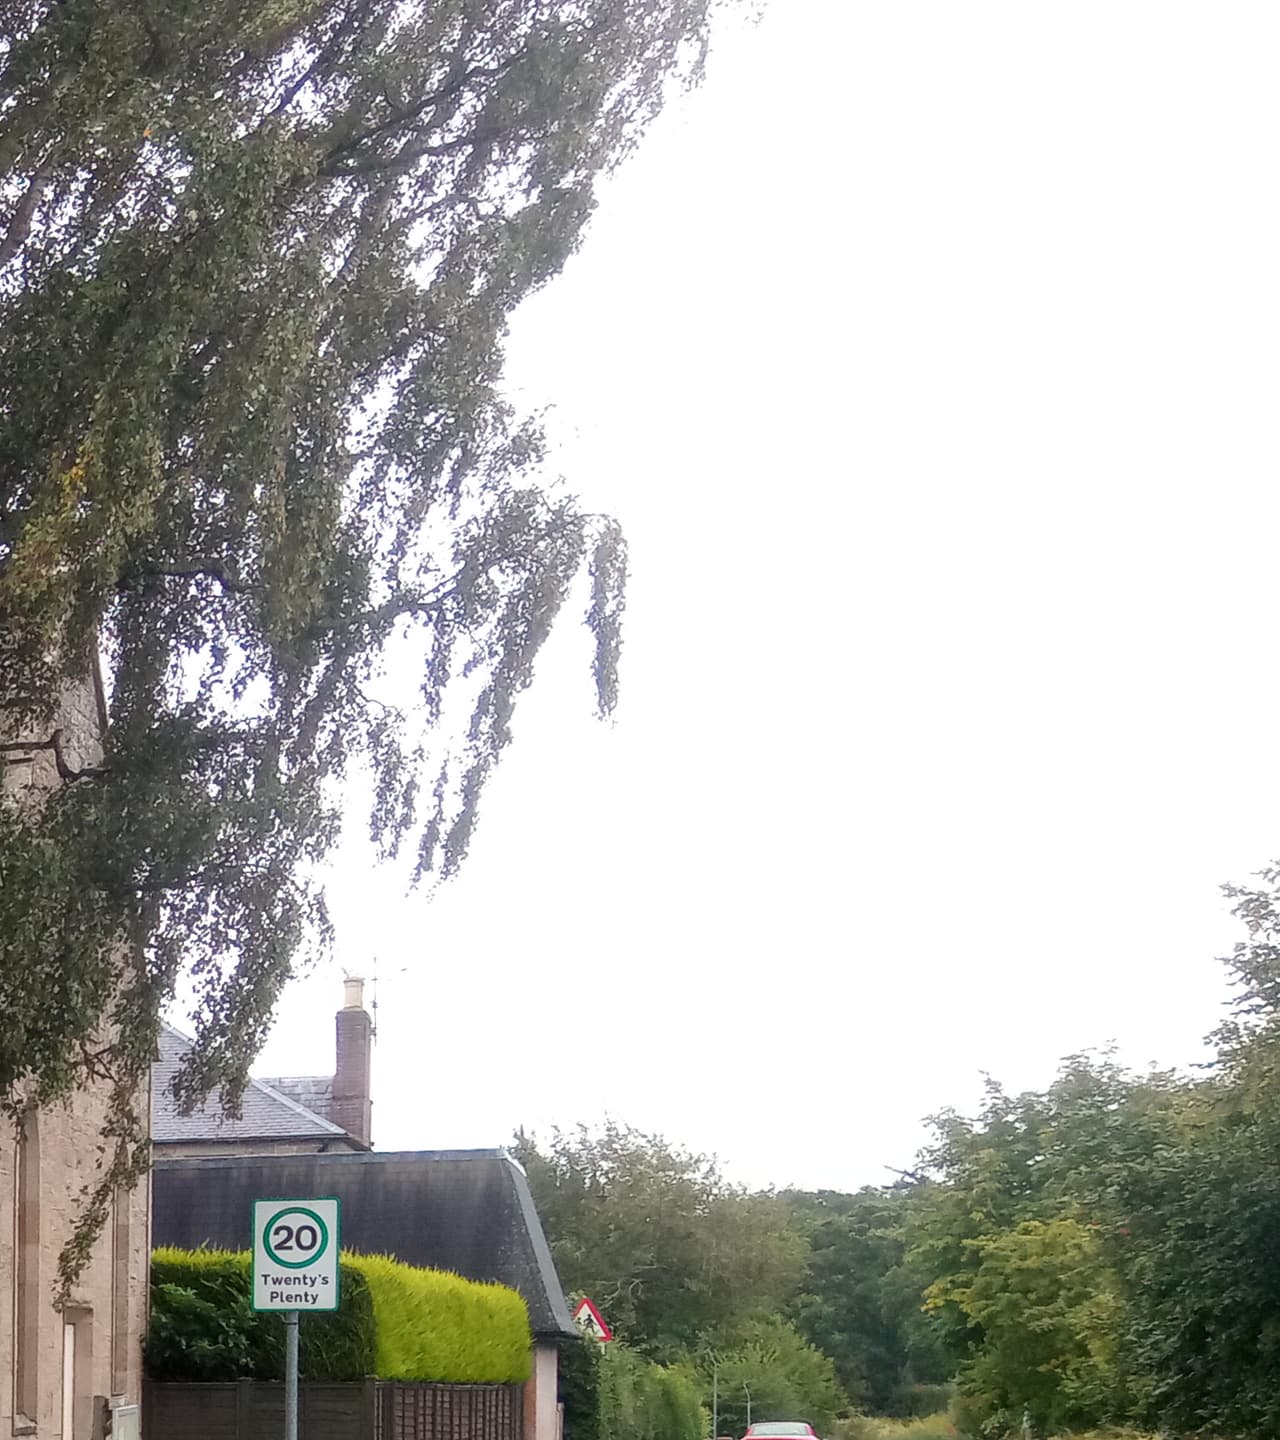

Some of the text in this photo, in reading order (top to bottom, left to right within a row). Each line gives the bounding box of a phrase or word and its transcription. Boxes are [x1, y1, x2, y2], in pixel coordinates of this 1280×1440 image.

[273, 1225, 317, 1251] 20
[261, 1273, 329, 1287] Twenty's
[269, 1291, 319, 1304] Plenty
